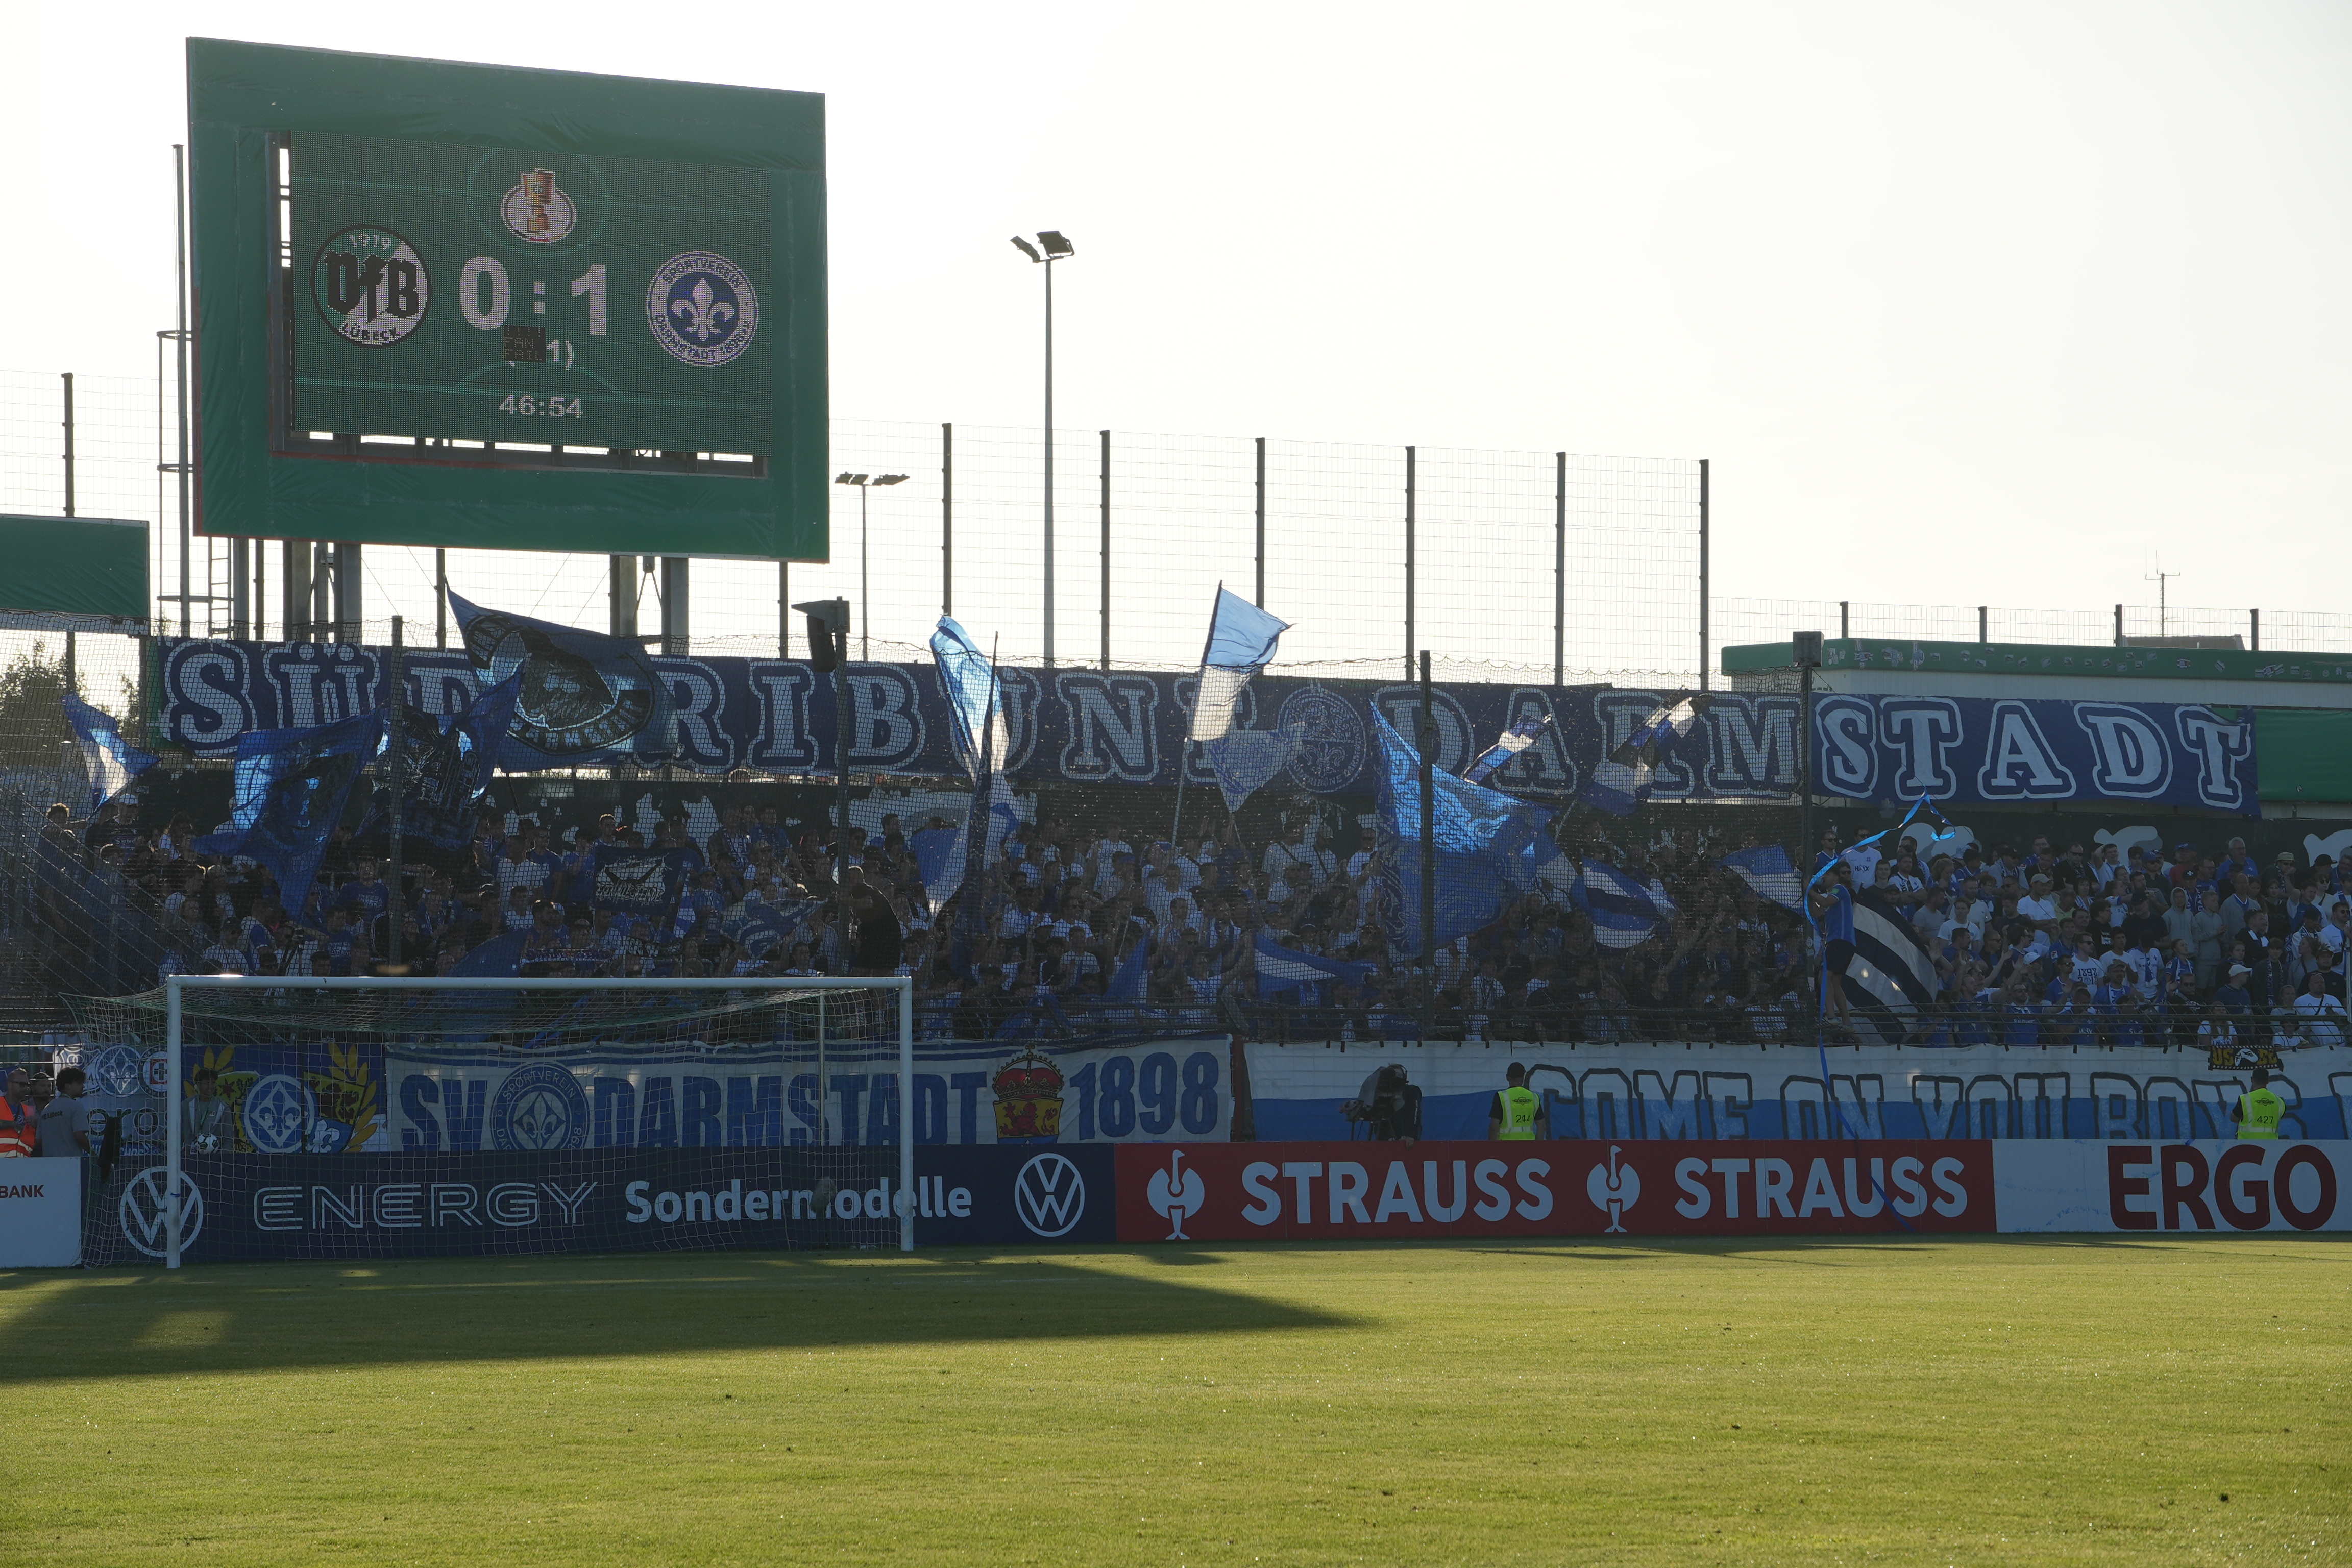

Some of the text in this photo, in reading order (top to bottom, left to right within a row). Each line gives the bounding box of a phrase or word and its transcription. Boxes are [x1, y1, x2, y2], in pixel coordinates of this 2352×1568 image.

[349, 233, 393, 250] 1919
[662, 257, 743, 288] SPORTVEREIN
[460, 256, 510, 331] 0
[572, 264, 607, 336] 1
[341, 321, 401, 341] LÜBECK
[499, 395, 583, 418] 46:54
[2078, 968, 2097, 977] 1898
[503, 1070, 576, 1100] SPORTVEREIN
[400, 1051, 1219, 1152] SV DARMSTADT 1898
[1524, 1063, 1753, 1139] COME
[1780, 1074, 1884, 1139] ON
[2257, 1115, 2274, 1124] 427
[0, 1185, 44, 1198] BANK
[254, 1175, 973, 1231] ENERGY Sondermodelle
[1241, 1158, 1554, 1226] STRAUSS
[1674, 1157, 1968, 1219] STRAUSS
[2107, 1144, 2337, 1231] ERGO
